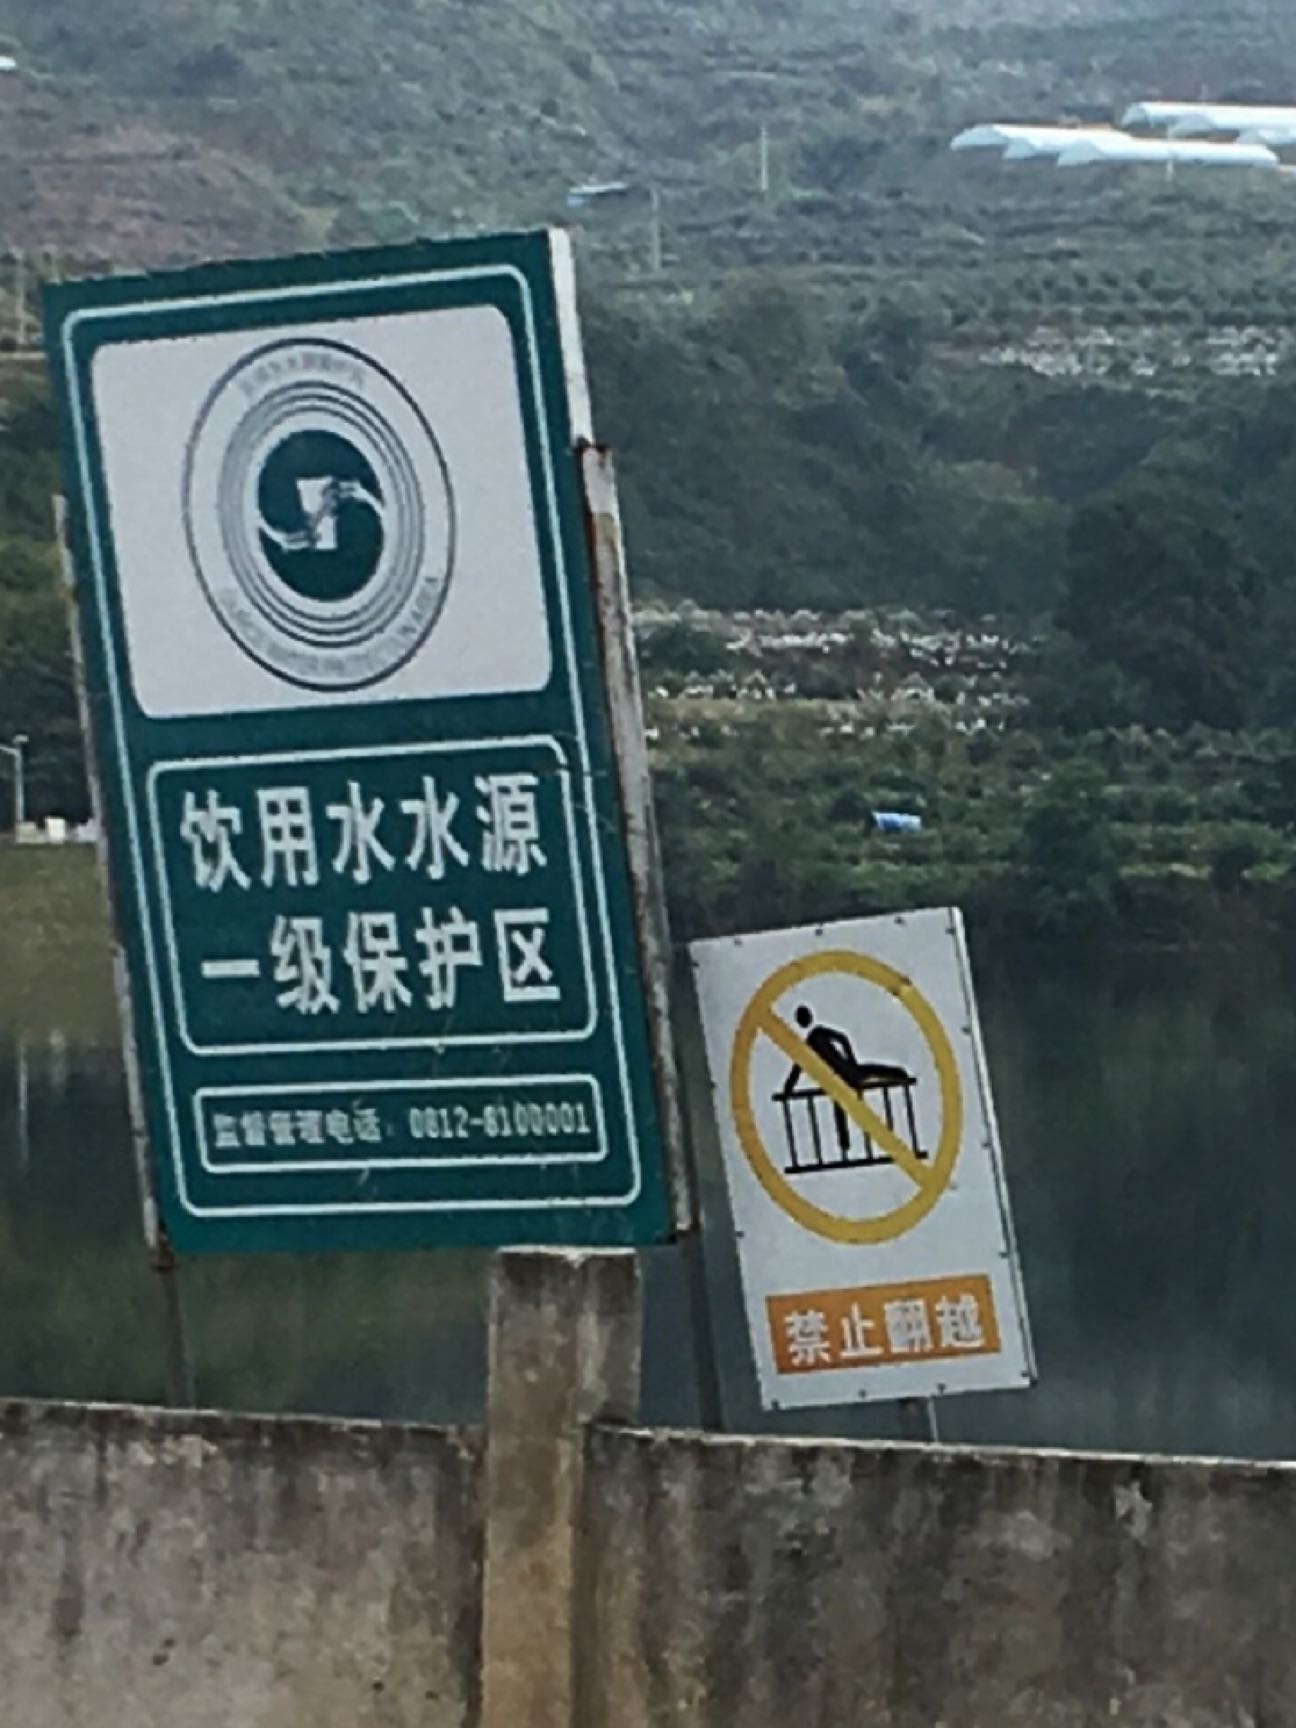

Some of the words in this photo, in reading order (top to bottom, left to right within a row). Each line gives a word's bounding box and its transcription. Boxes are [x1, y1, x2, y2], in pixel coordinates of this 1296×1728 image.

[180, 774, 547, 891] 饮用水水源
[202, 906, 561, 1015] 一级保护区
[784, 1292, 986, 1365] 禁止翻越
